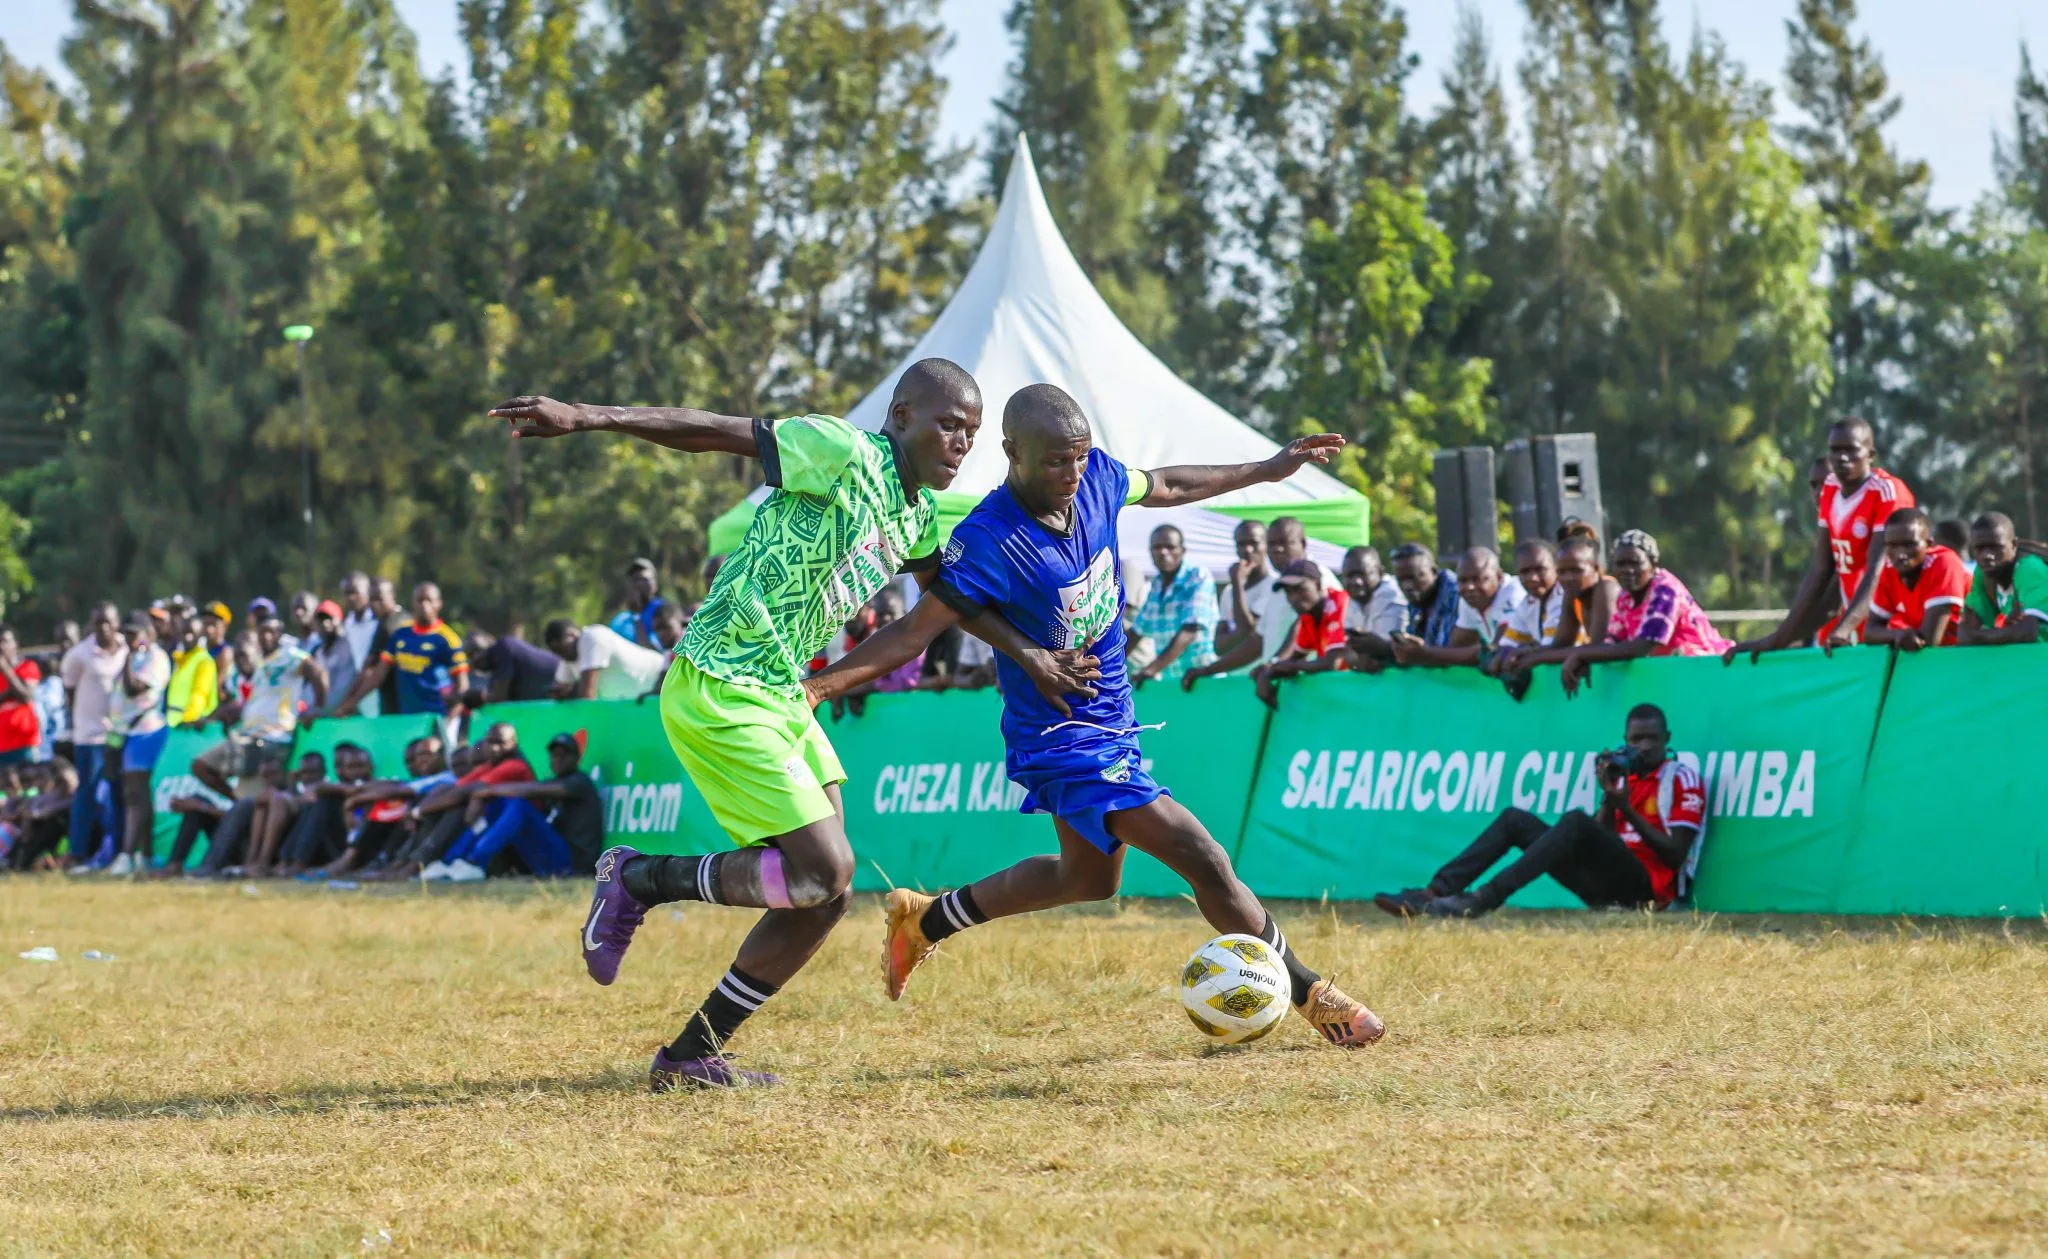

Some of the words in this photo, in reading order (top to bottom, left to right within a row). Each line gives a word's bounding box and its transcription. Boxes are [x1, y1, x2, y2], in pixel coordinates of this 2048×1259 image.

[873, 762, 962, 814] CHEZA
[1281, 750, 1506, 813] SAFARICOM
[1512, 750, 1598, 816] CHA
[1239, 967, 1277, 987] molten
